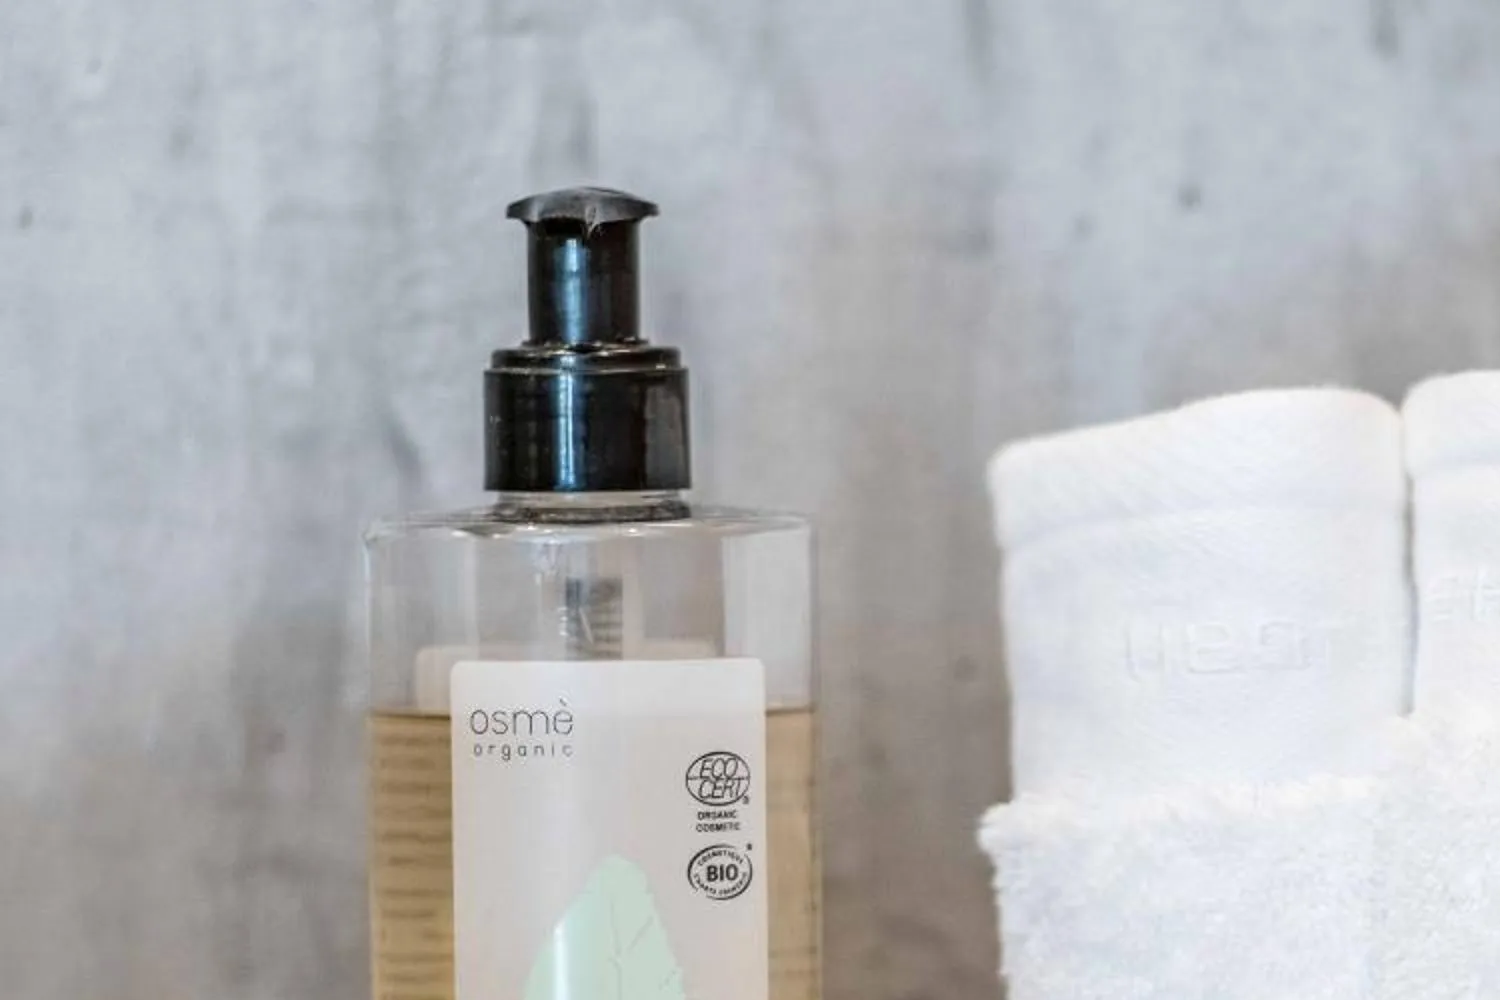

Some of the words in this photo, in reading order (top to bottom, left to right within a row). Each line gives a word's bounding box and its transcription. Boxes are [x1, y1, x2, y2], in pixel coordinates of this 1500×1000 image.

[469, 698, 574, 736] osmè
[473, 742, 574, 761] organic
[700, 757, 738, 779] ECO
[698, 779, 741, 799] CERT
[697, 810, 737, 821] ORGANIC
[695, 822, 741, 833] COSMETIC
[706, 863, 739, 882] BIO
